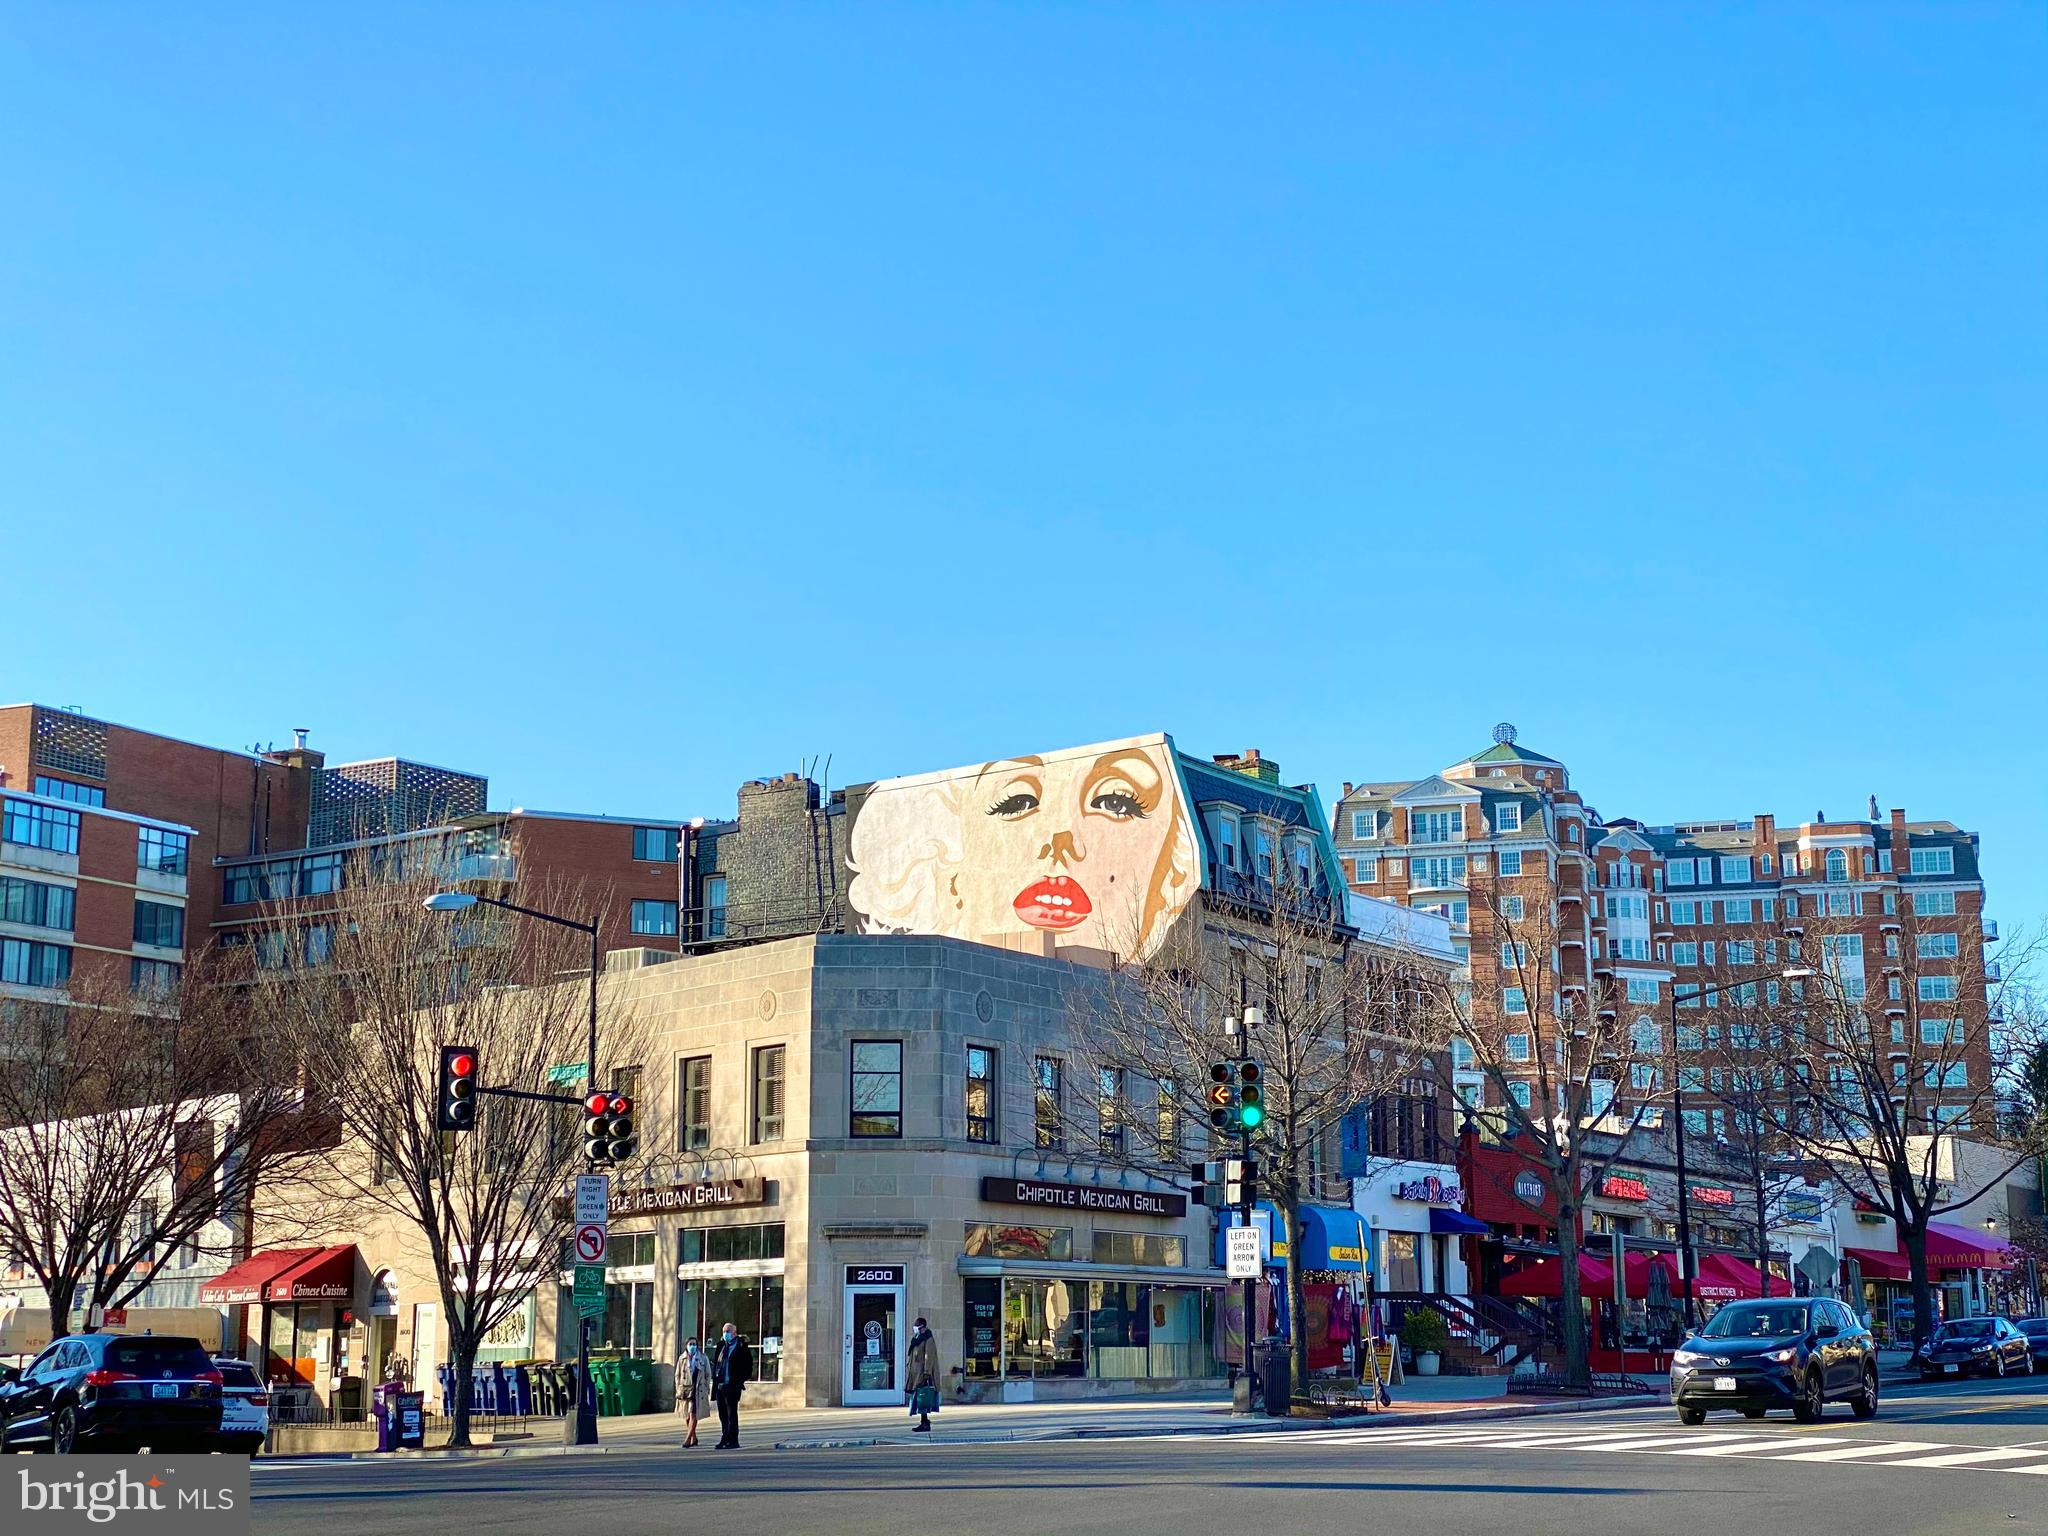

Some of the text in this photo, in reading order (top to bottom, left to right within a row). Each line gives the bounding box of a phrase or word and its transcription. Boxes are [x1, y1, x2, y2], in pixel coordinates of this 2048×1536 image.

[1518, 1181, 1541, 1197] DISTRICT
[636, 1188, 692, 1210] MEXICAN
[695, 1185, 733, 1205] GRILL
[1016, 1183, 1165, 1213] CHIPOTLE MEXICAN GRILL
[1230, 1231, 1257, 1240] LEFT ON
[857, 1270, 893, 1281] 2600
[292, 1283, 321, 1297] Chinese
[321, 1283, 348, 1297] Cuisine
